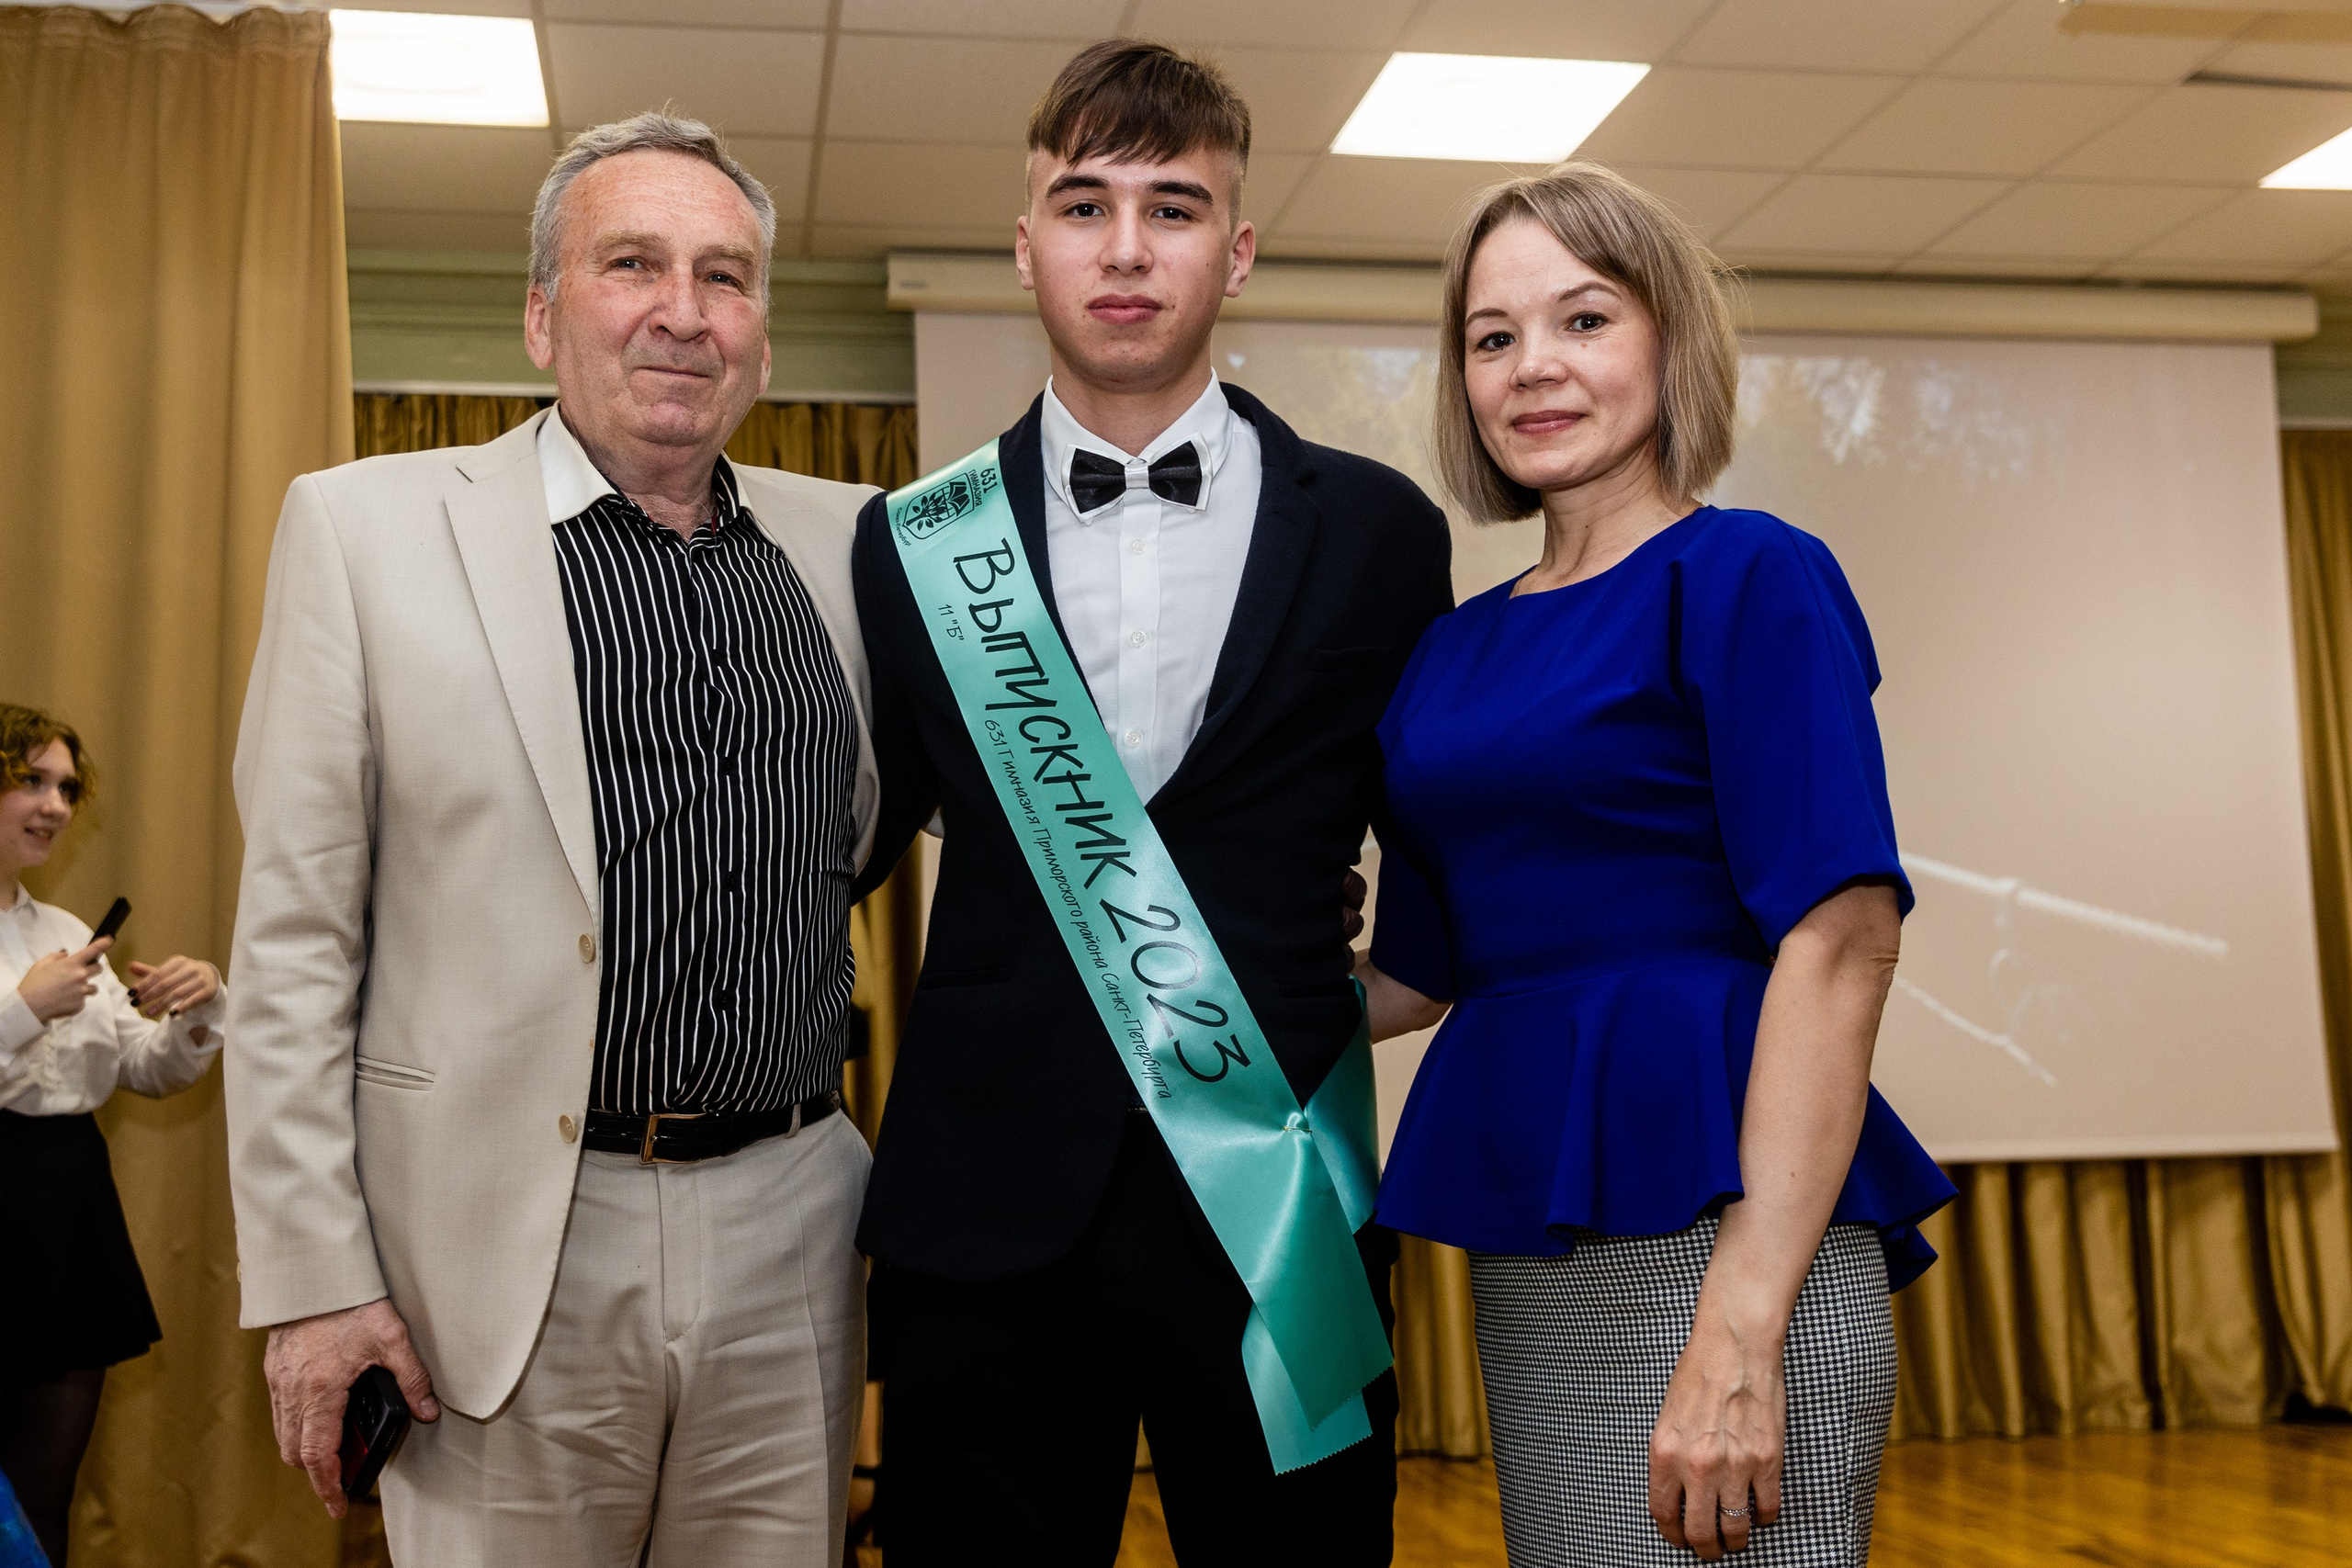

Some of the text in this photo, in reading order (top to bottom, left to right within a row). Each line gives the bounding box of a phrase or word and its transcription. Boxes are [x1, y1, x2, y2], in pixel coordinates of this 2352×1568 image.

[967, 468, 983, 508] ГИМНАЗИЯ
[979, 467, 999, 494] 631
[896, 506, 911, 547] Санкт-Петербург
[937, 603, 955, 617] 11
[983, 719, 1172, 1100] 631 Гимназия Приморского района Санкт-Петербурга
[1098, 897, 1253, 1084] 2023
